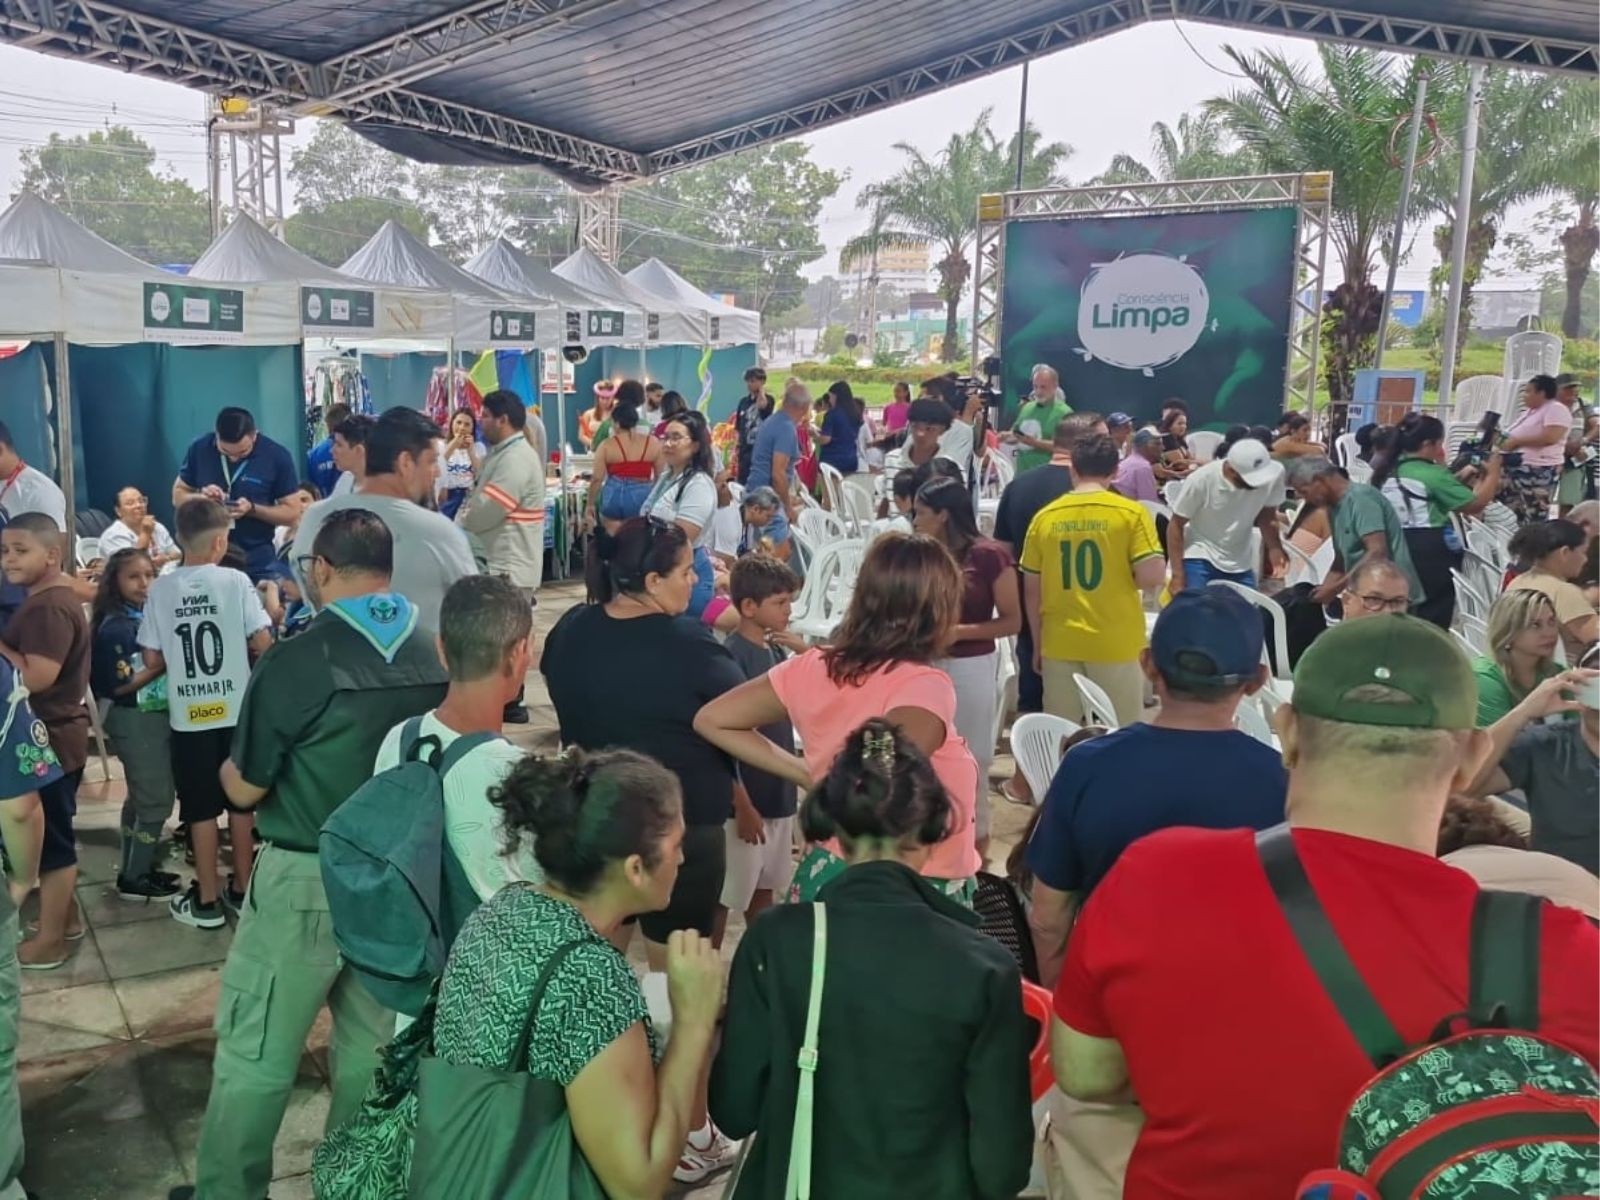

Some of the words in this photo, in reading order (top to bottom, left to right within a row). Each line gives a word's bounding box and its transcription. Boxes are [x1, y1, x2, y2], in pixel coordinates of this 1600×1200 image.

[1092, 303, 1190, 333] Limpa
[1060, 539, 1103, 591] 10
[182, 595, 209, 606] VIVA
[174, 605, 218, 618] SORTE
[174, 620, 224, 678] 10
[177, 681, 220, 697] NEYMAR
[190, 706, 224, 720] placo
